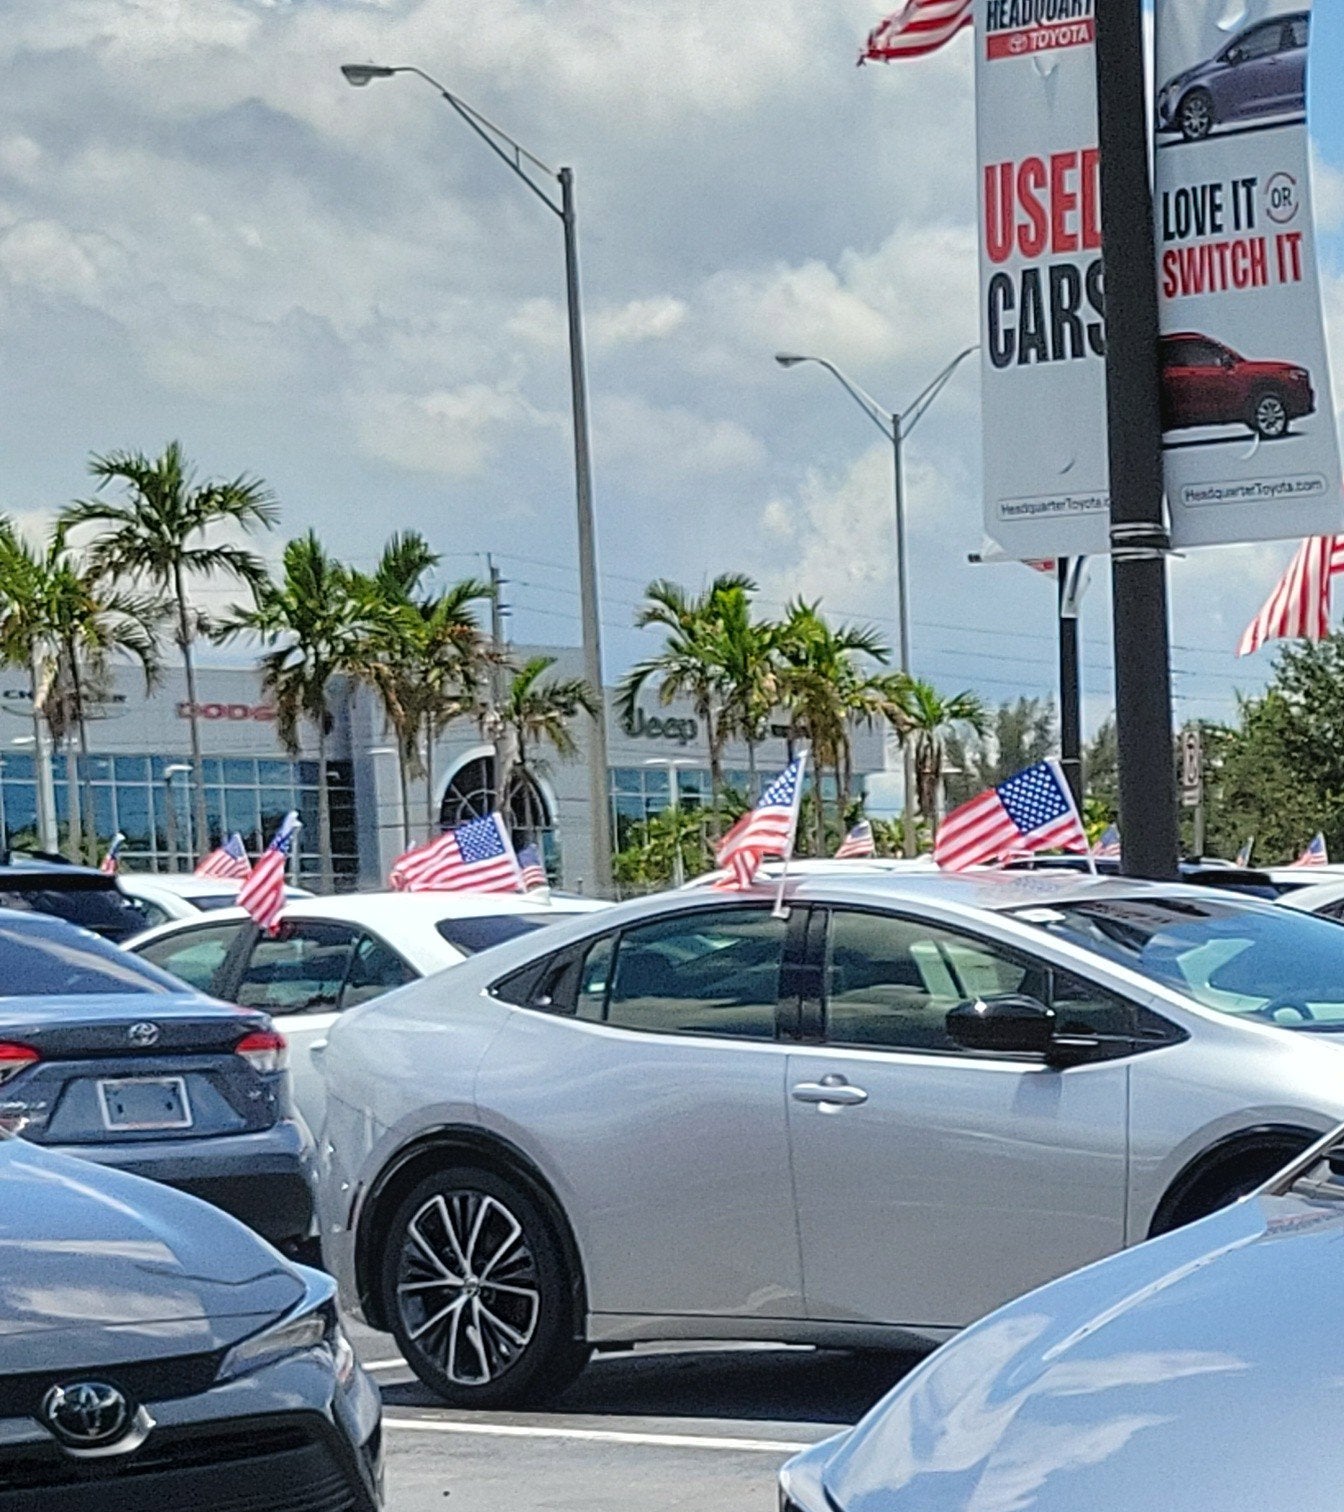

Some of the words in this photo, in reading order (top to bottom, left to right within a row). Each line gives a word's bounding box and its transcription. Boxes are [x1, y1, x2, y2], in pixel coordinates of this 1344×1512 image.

[1029, 24, 1089, 50] TOYOTA
[985, 148, 1102, 264] USED
[1163, 183, 1223, 241] LOVE
[1232, 177, 1257, 231] IT
[1271, 187, 1292, 208] OR
[1163, 237, 1267, 298] SWITCH
[1276, 231, 1302, 284] IT
[988, 259, 1106, 369] CARS
[178, 703, 277, 720] DODG
